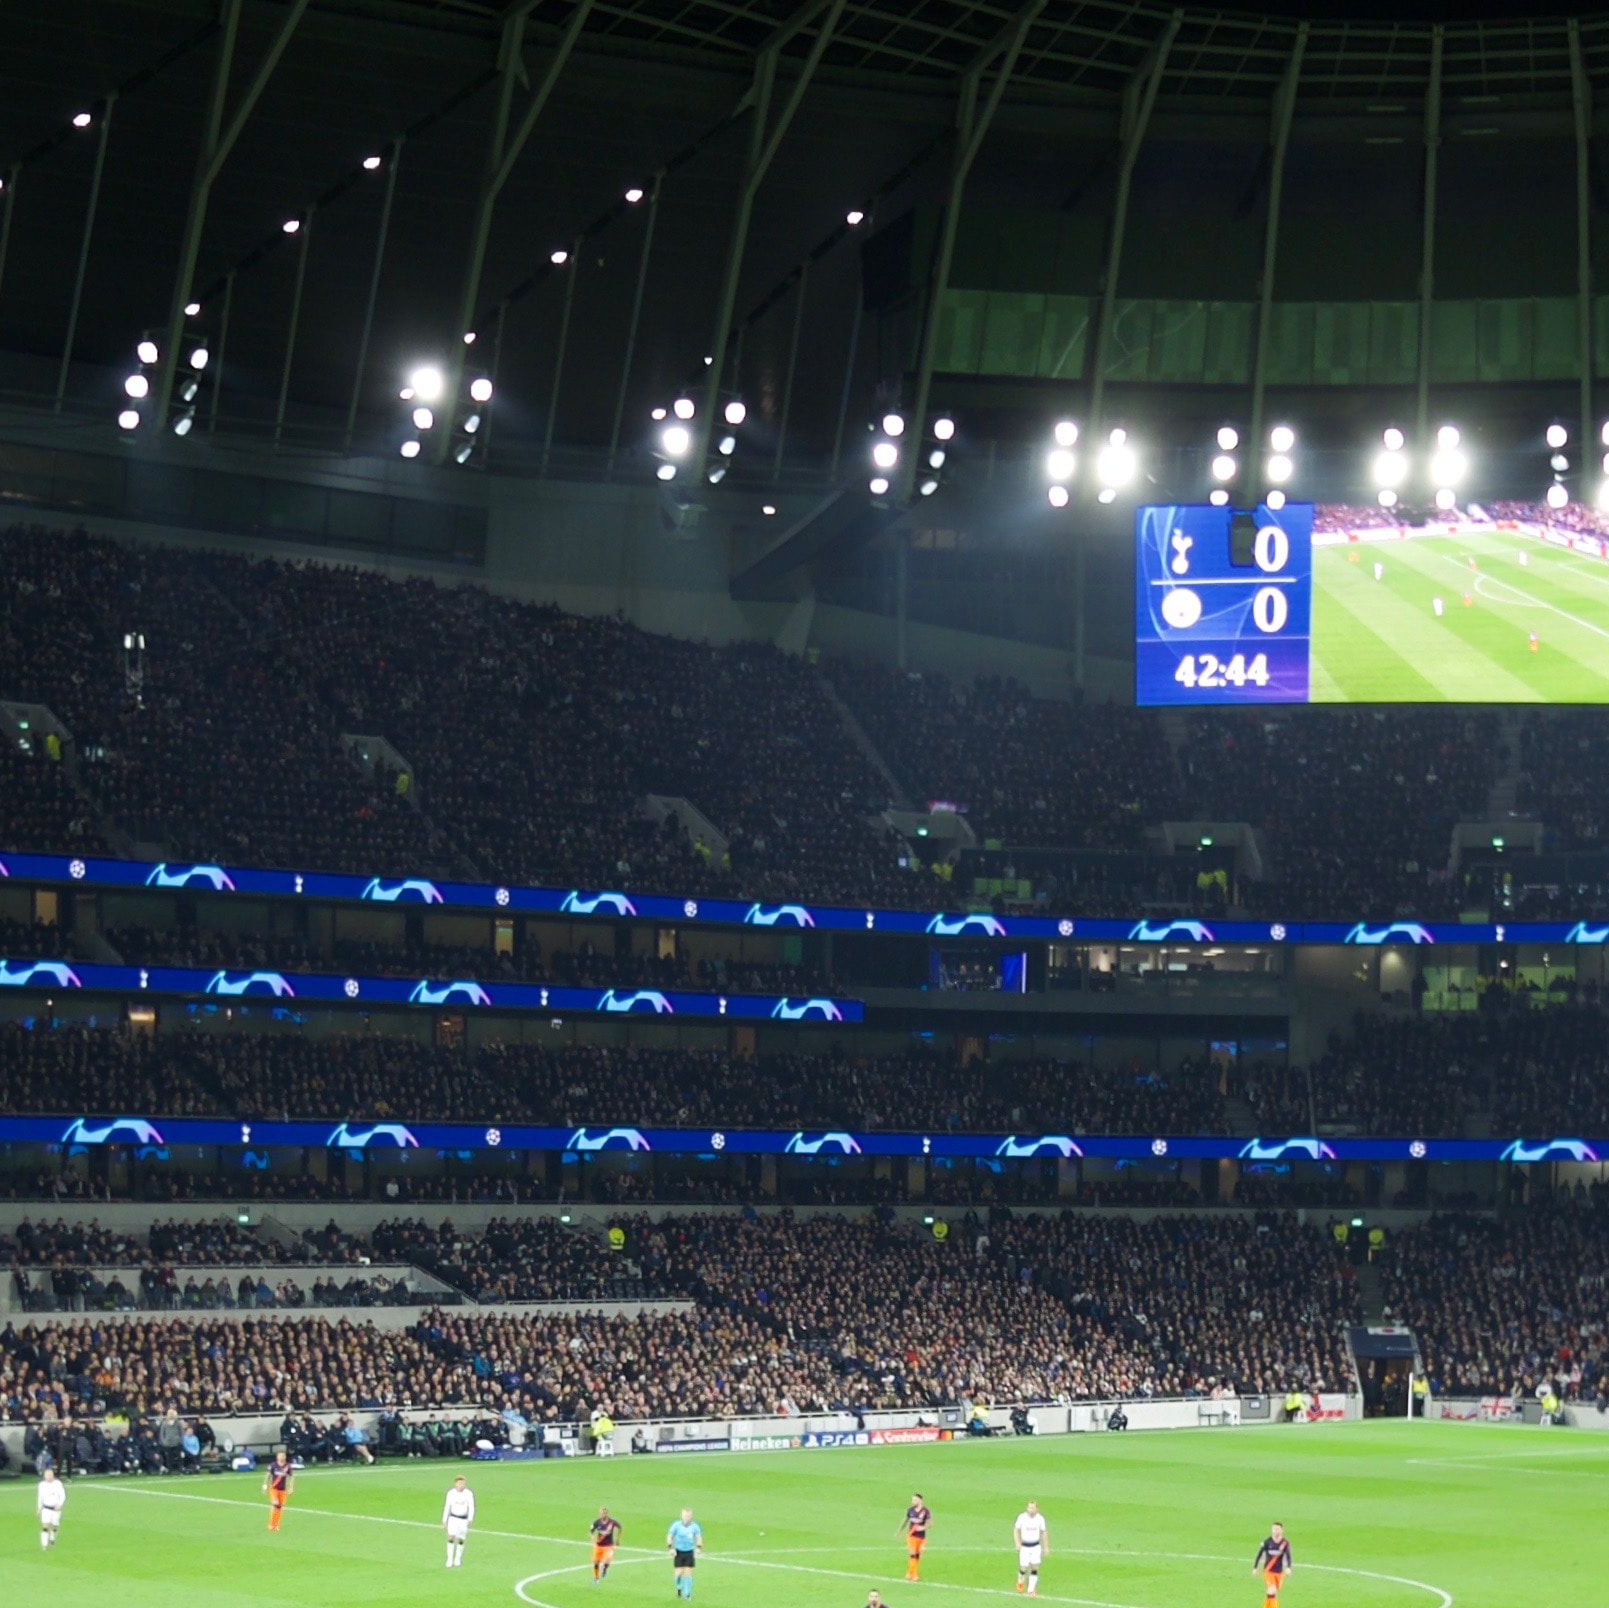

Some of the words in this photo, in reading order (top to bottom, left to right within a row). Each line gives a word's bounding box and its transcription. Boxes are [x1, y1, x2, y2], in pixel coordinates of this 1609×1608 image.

[1255, 526, 1289, 572] 0
[1253, 587, 1288, 632] 0
[1175, 653, 1270, 687] 42:44
[732, 1437, 791, 1451] Heineken
[822, 1434, 855, 1447] PS4
